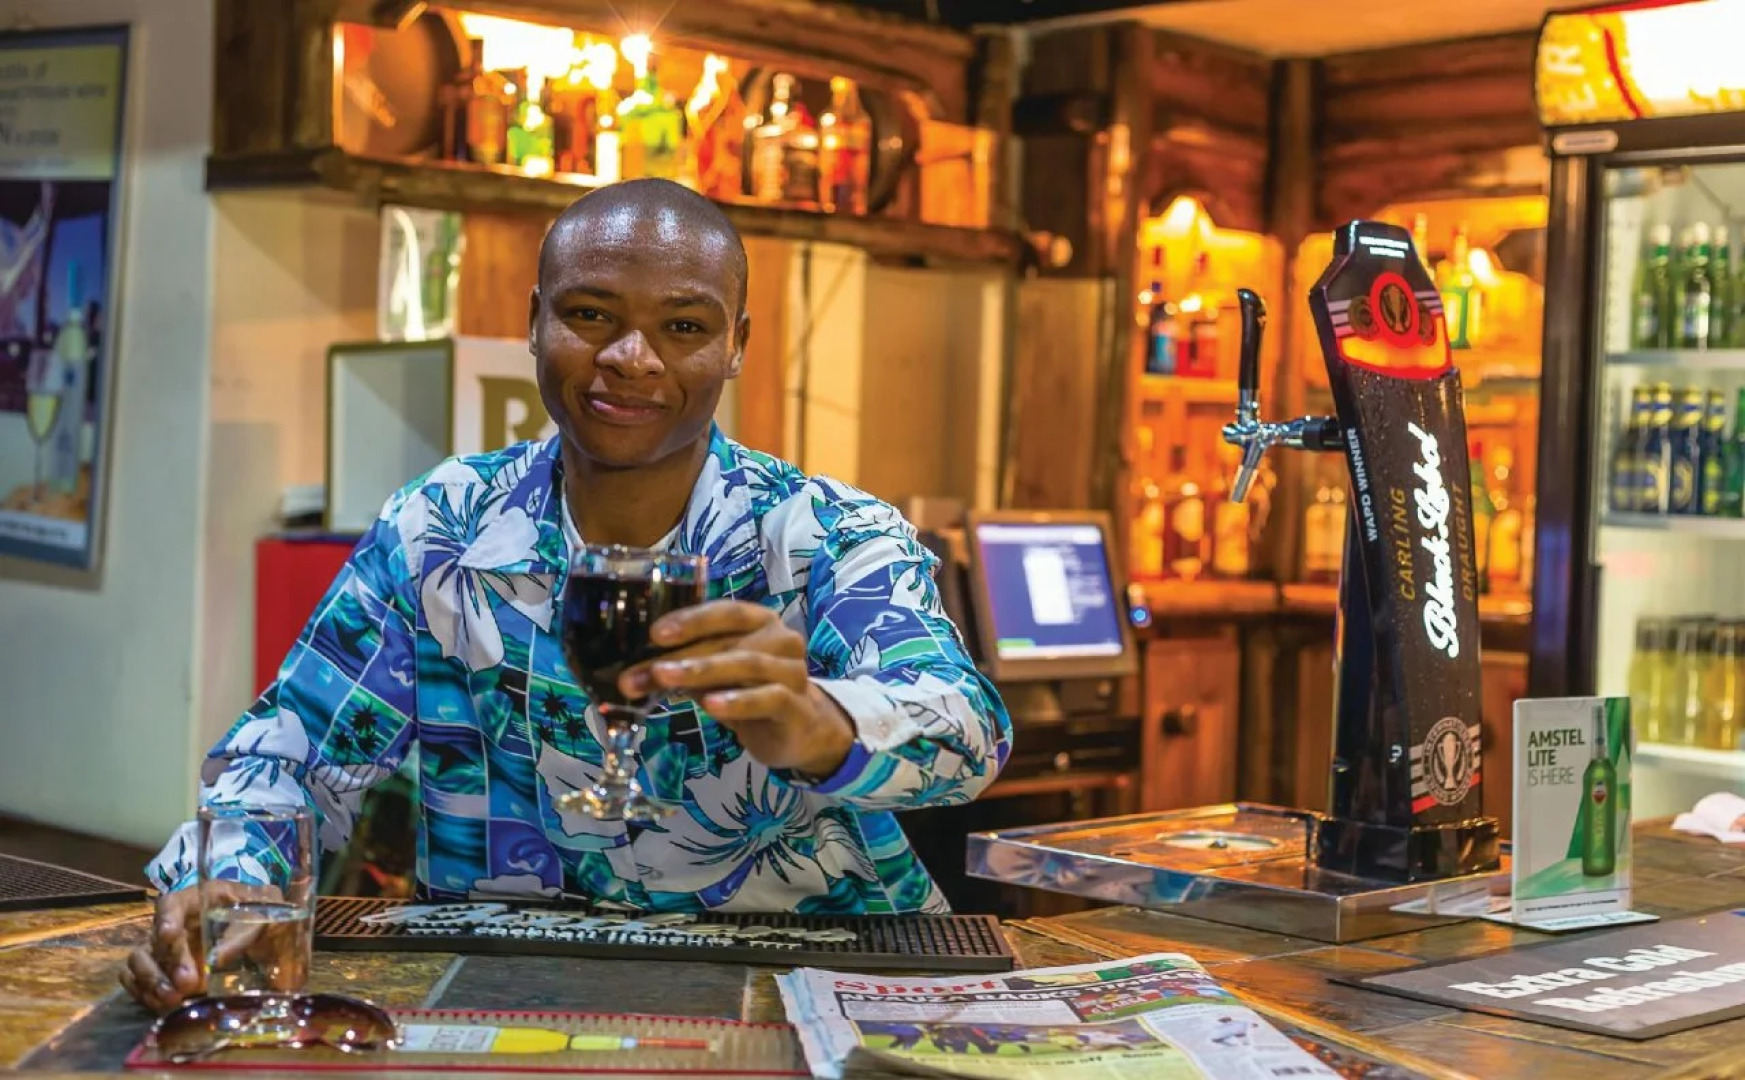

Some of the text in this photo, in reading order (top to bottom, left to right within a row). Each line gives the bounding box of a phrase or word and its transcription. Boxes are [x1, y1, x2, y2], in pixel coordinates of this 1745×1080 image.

[1346, 427, 1369, 491] WINNER
[1389, 486, 1416, 601] CARLING
[1452, 479, 1473, 602] DRAUGHT
[1527, 728, 1586, 747] AMSTEL
[1527, 748, 1557, 767] LITE
[1527, 766, 1576, 786] IS HERE
[1448, 944, 1718, 999] Extra Cold
[833, 978, 1003, 994] Sport
[975, 988, 1080, 1001] BACKS
